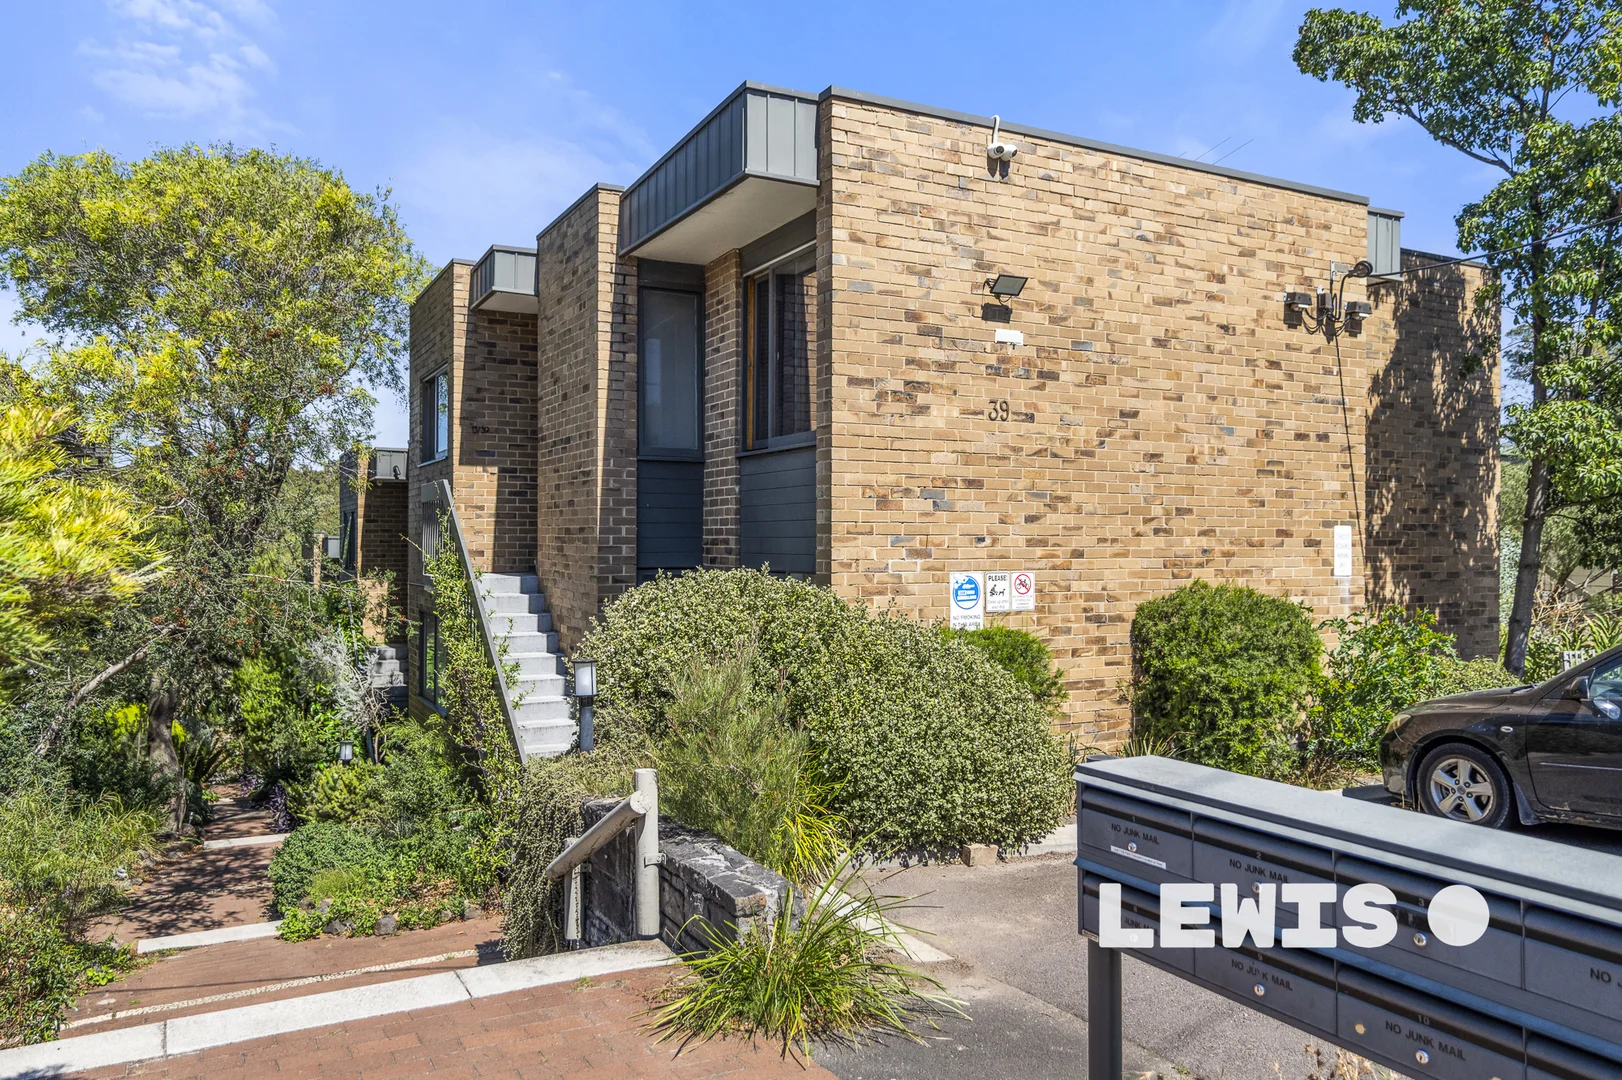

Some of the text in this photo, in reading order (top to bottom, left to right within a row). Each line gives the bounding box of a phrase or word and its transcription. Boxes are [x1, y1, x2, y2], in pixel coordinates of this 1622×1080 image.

[988, 400, 1009, 421] 39
[1111, 823, 1160, 845] NO JUNK MAIL
[1256, 852, 1262, 860] 2
[1229, 858, 1289, 883] NO JUNK MAIL
[1418, 898, 1425, 907] 3
[1231, 958, 1244, 970] NO
[1271, 974, 1293, 991] MAIL
[1590, 967, 1612, 984] NO
[1417, 1014, 1430, 1026] 10
[1385, 1020, 1466, 1061] NO JUNK MAIL
